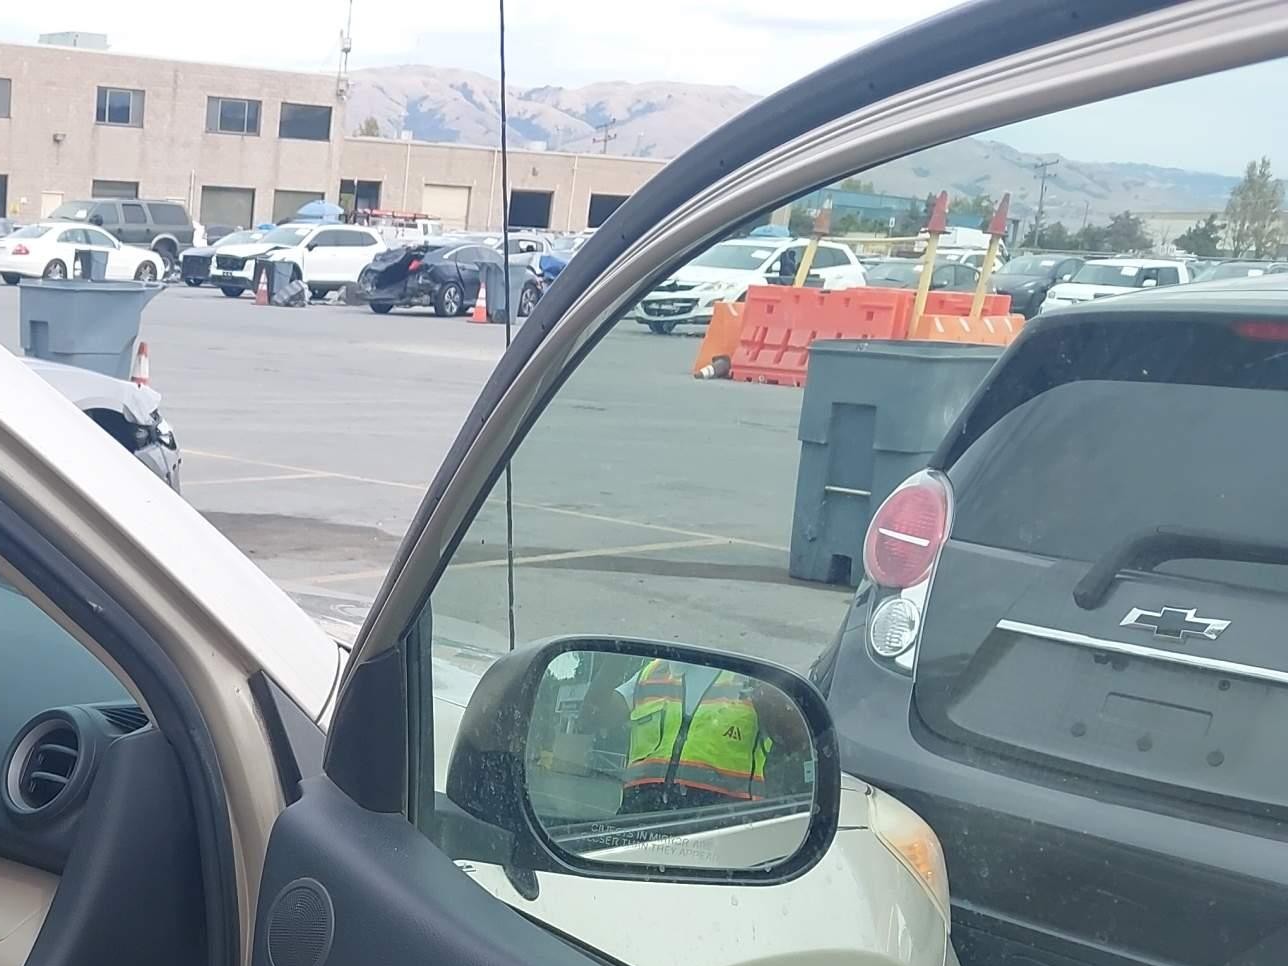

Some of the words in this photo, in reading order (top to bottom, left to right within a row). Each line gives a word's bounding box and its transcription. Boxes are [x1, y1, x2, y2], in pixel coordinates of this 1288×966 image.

[636, 830, 648, 841] IN
[649, 832, 689, 846] MIRROR
[651, 843, 677, 856] THEY
